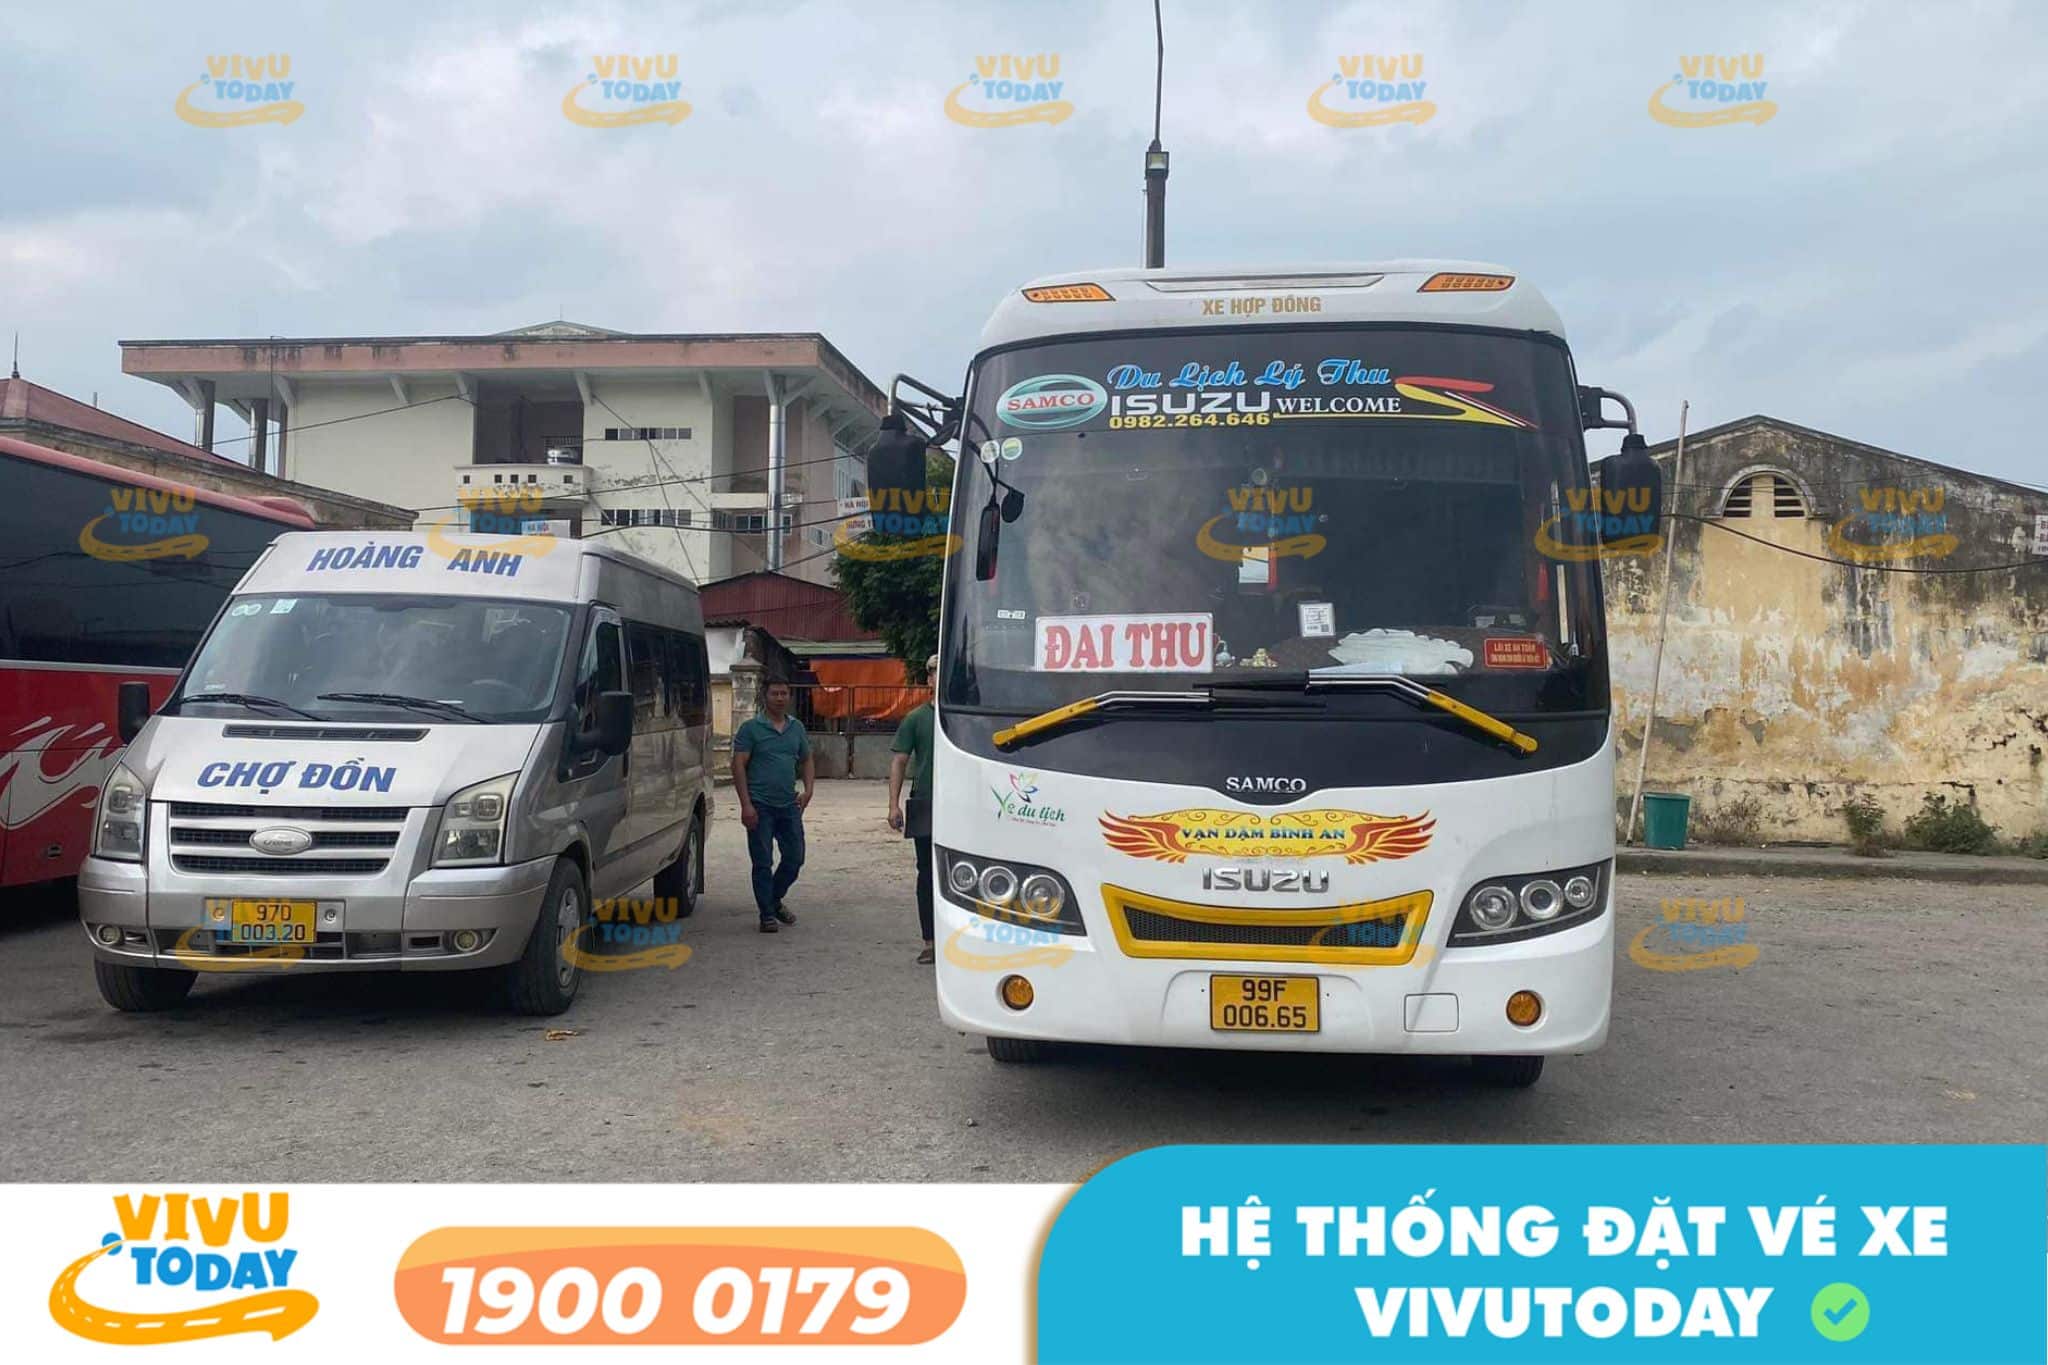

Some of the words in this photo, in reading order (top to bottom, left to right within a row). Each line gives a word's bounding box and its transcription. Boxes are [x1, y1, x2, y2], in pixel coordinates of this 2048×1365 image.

[1203, 299, 1225, 315] XE
[1230, 296, 1266, 318] HỢP
[1107, 364, 1163, 390] Du
[1169, 361, 1248, 391] Lịch
[1317, 358, 1392, 386] Thu
[1007, 393, 1096, 412] SAMCO
[1111, 391, 1271, 417] ISUZU
[1276, 397, 1402, 414] WELCOME
[1108, 412, 1271, 430] 0982.264.646
[306, 541, 424, 571] HOÀNG
[447, 548, 523, 577] ANH
[1044, 625, 1115, 670] ĐAI
[1125, 622, 1207, 668] THU
[197, 760, 296, 795] CHỢ
[298, 757, 397, 793] ĐỒN
[1226, 776, 1307, 793] SAMCO
[1018, 804, 1036, 818] du
[1040, 806, 1065, 822] lịch
[1181, 827, 1220, 841] VẠN
[1319, 828, 1346, 840] AN
[1203, 866, 1330, 894] ISUZU
[241, 924, 306, 941] 003.20
[1242, 979, 1288, 1002] 99F
[1223, 1004, 1307, 1028] 006.65
